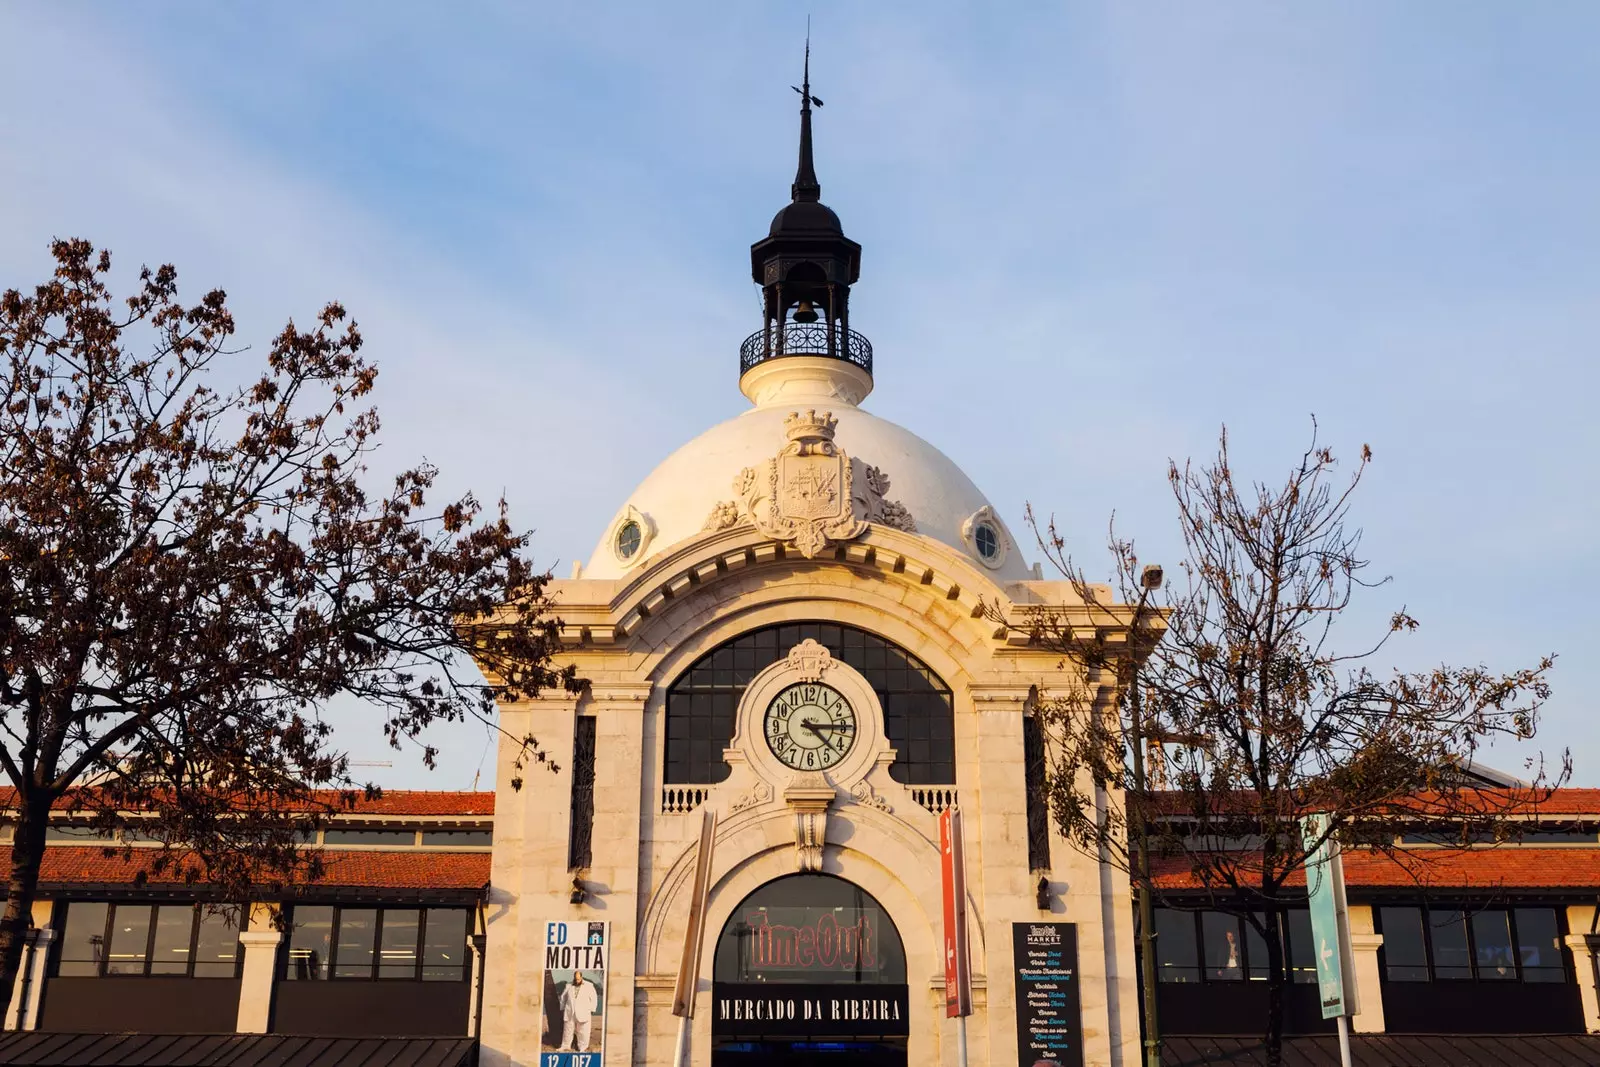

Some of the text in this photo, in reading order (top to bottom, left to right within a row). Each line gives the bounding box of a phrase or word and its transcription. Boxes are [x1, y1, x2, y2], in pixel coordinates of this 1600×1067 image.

[789, 691, 798, 706] 11
[805, 687, 815, 702] 12
[823, 691, 828, 706] 1
[776, 703, 787, 718] 10
[836, 702, 842, 717] 2
[772, 719, 780, 734] 9
[777, 736, 784, 752] 8
[836, 736, 845, 751] 4
[789, 749, 797, 764] 7
[807, 752, 814, 767] 6
[823, 748, 830, 763] 5
[547, 922, 567, 945] ED
[546, 946, 604, 969] MOTTA
[1027, 950, 1047, 958] Comida
[720, 999, 901, 1020] MERCADO DA RIBEIRA
